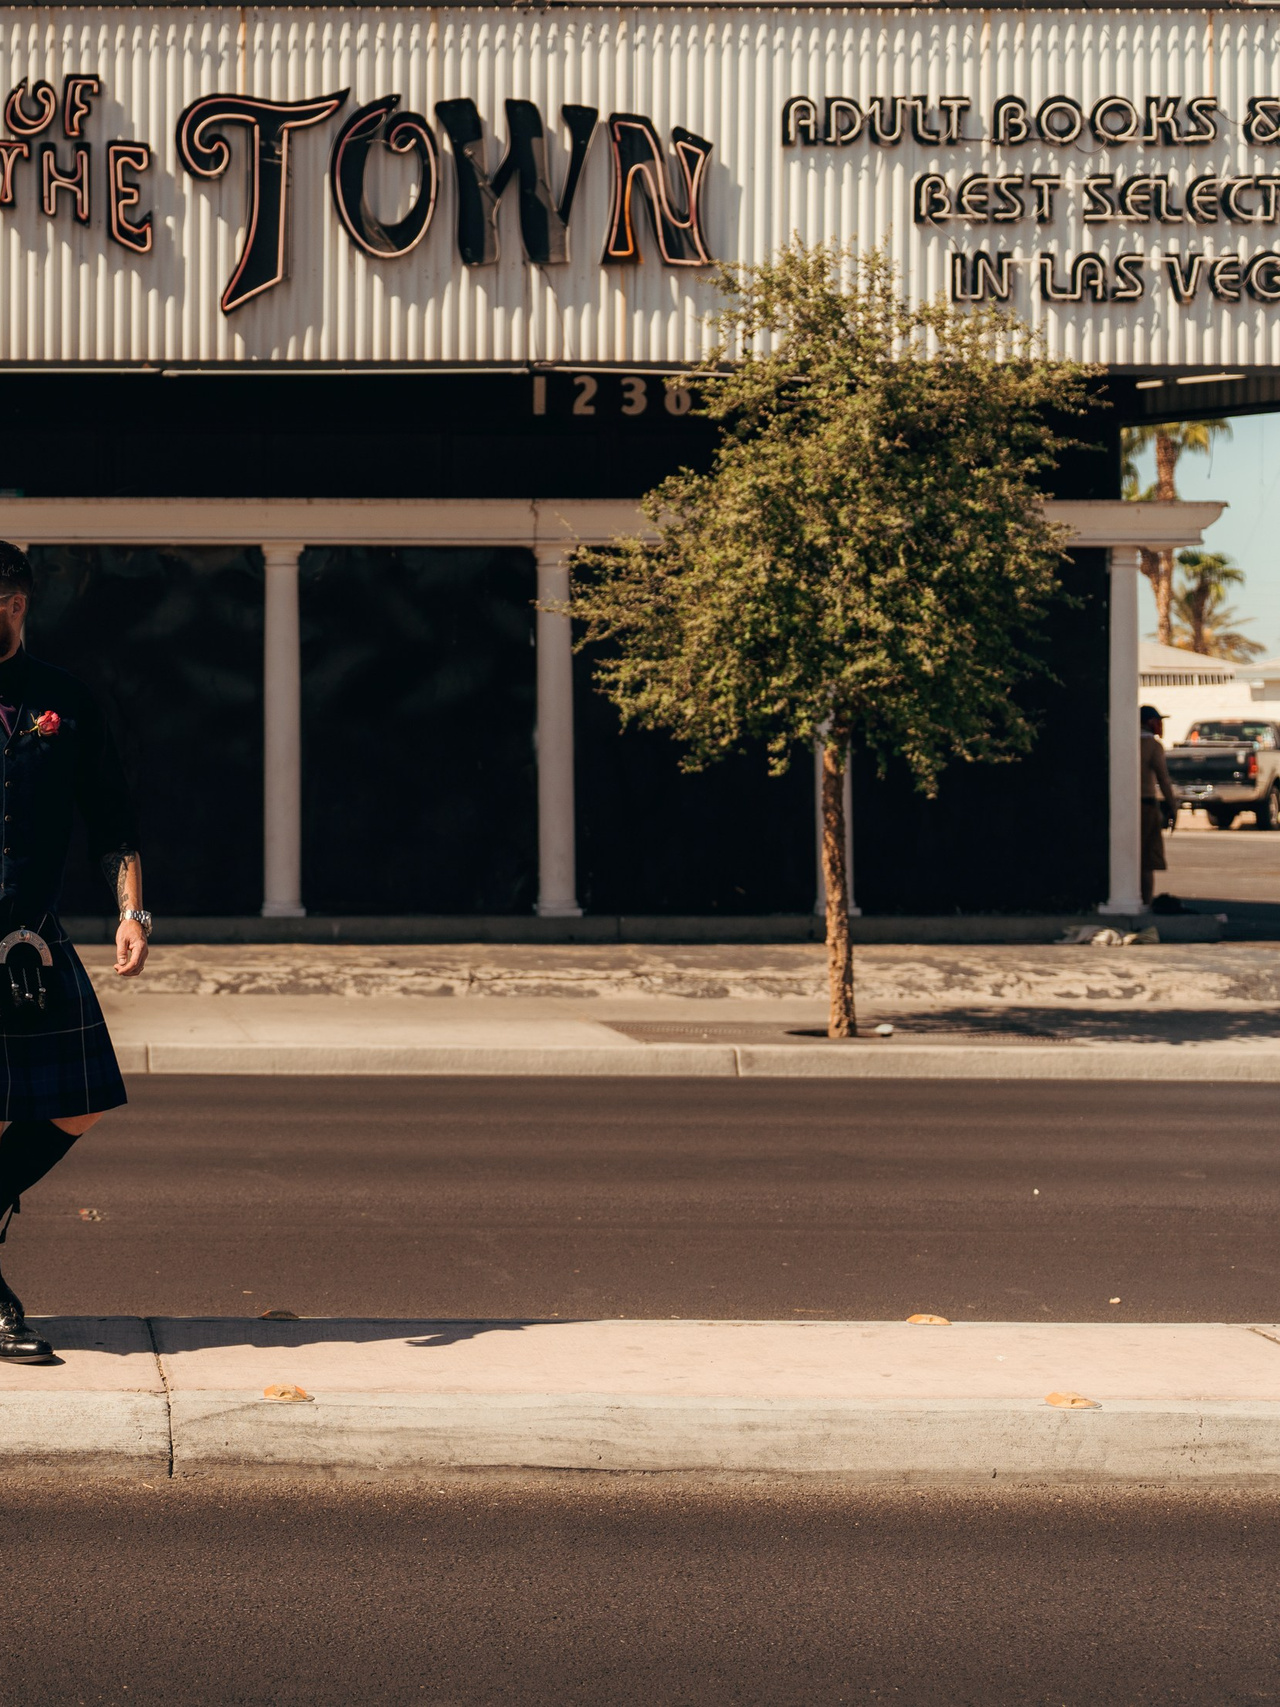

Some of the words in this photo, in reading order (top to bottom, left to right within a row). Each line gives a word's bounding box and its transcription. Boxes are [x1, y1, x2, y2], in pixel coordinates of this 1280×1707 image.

[782, 95, 971, 147] ADULT
[993, 95, 1218, 147] BOOKS
[1243, 96, 1280, 147] &
[4, 74, 100, 138] OF
[176, 87, 714, 315] TOWN
[914, 173, 1062, 224] BEST
[1083, 173, 1280, 224] SELECT
[951, 250, 1015, 302] IN
[1040, 251, 1145, 303] LAS
[1167, 251, 1280, 304] VEG
